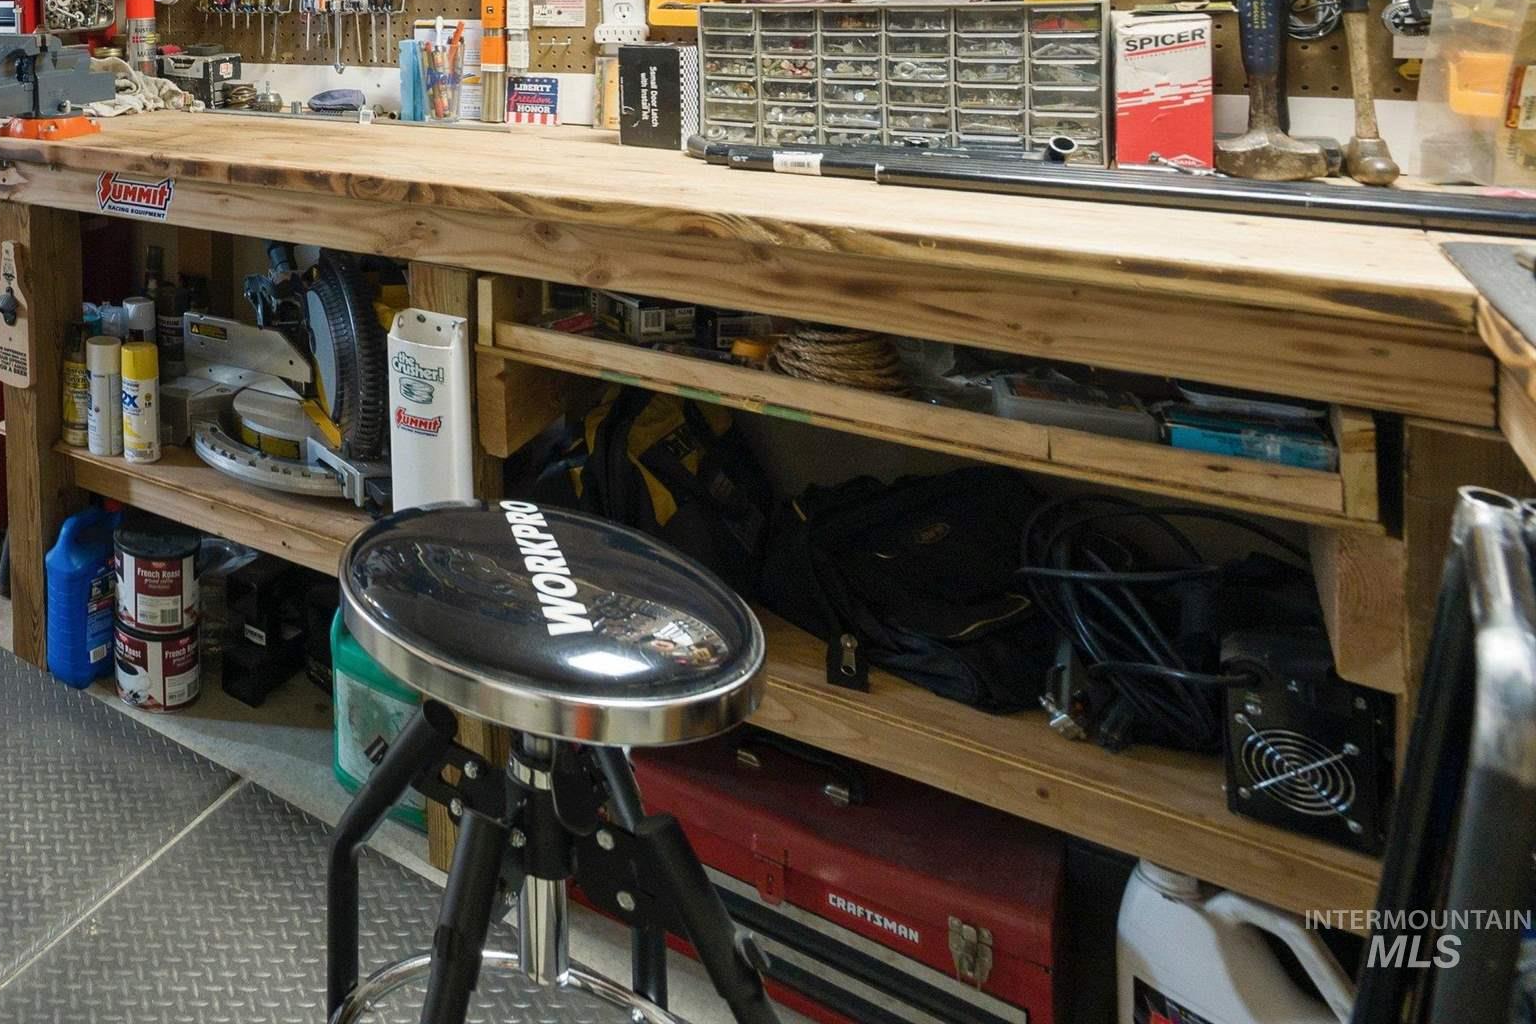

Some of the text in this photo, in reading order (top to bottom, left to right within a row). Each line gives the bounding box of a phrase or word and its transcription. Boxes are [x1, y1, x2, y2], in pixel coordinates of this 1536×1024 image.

[1125, 28, 1205, 52] SPICER
[640, 72, 648, 87] with
[515, 83, 552, 92] LIBERTY
[649, 66, 659, 127] Small Door Latch
[517, 105, 551, 113] HONOR
[108, 205, 165, 219] RACING EQUIPMENT
[398, 351, 415, 366] the
[392, 357, 445, 384] Crusher!
[137, 568, 180, 580] French Roast
[499, 500, 594, 637] WORKPRO
[828, 893, 920, 945] CRAFTSMAN
